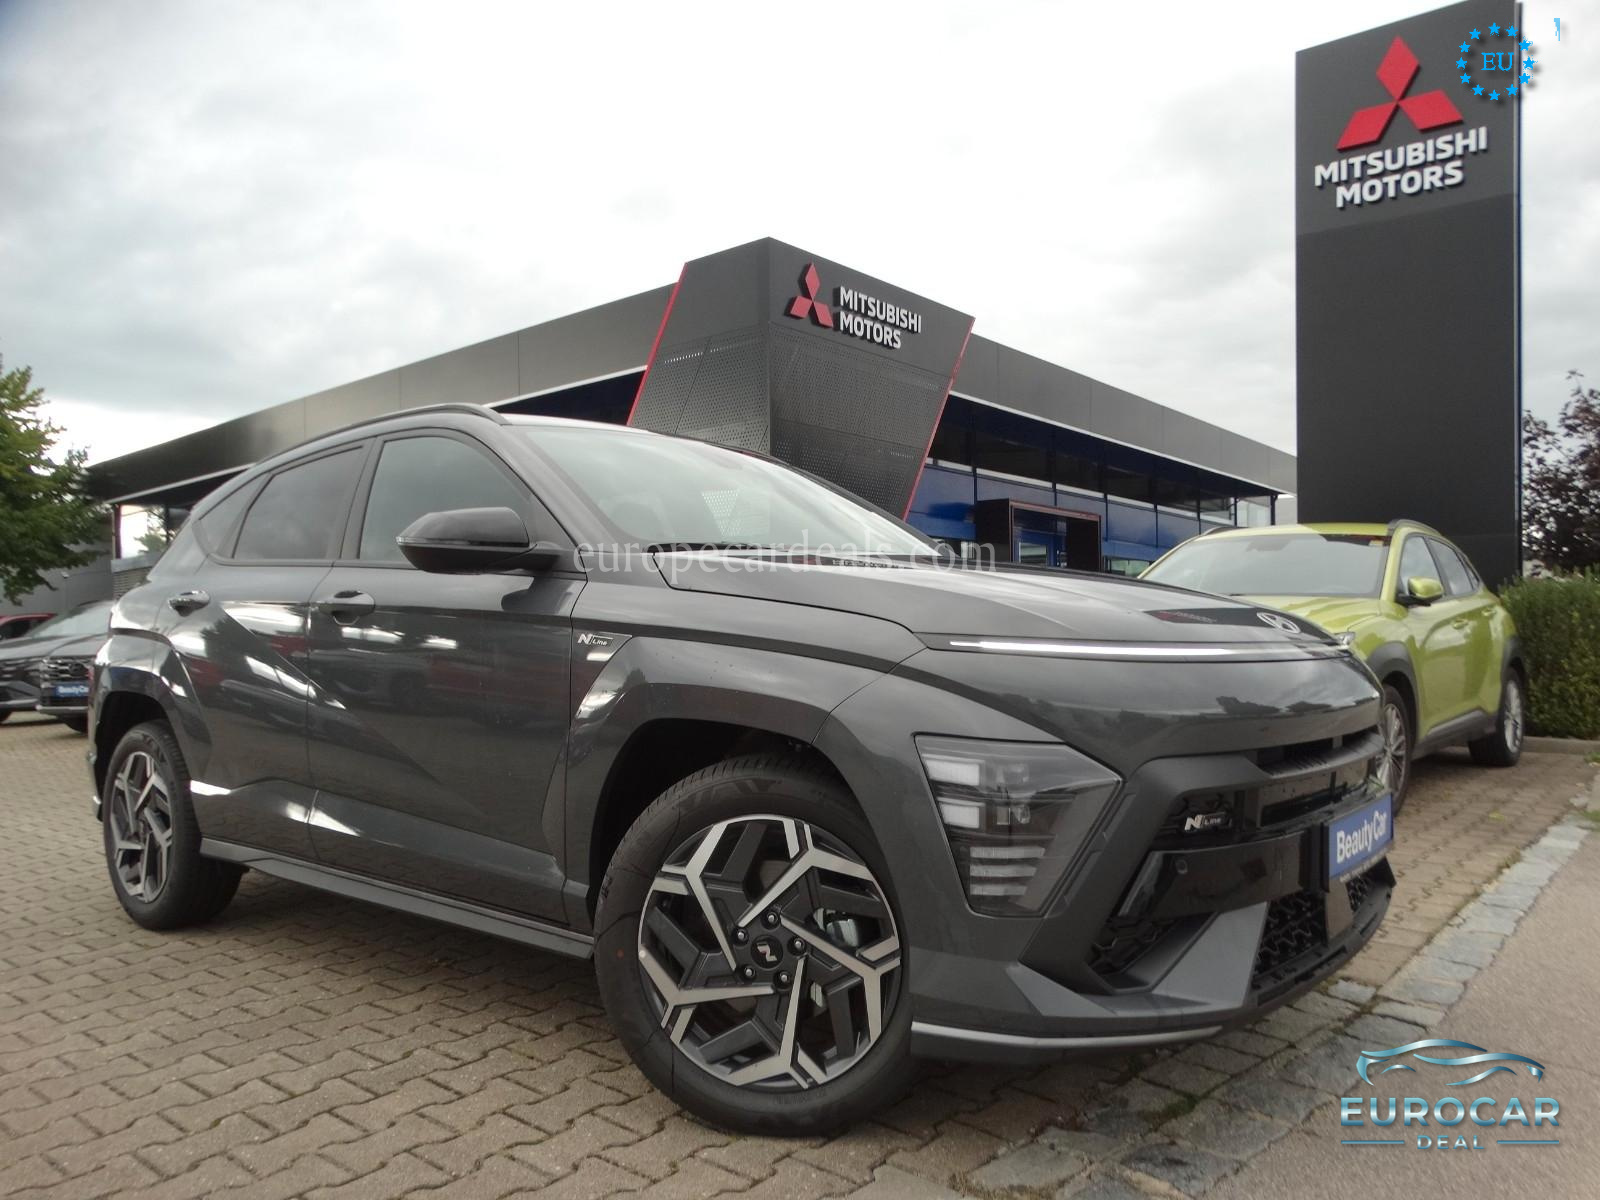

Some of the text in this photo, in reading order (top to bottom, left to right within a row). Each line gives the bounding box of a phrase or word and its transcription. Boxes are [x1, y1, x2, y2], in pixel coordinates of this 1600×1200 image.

[1314, 126, 1488, 186] MITSUBISHI
[1336, 160, 1464, 208] MOTORS
[839, 285, 922, 334] MITSUBISHI
[839, 310, 902, 349] MOTORS
[1336, 810, 1387, 864] BeautyCar
